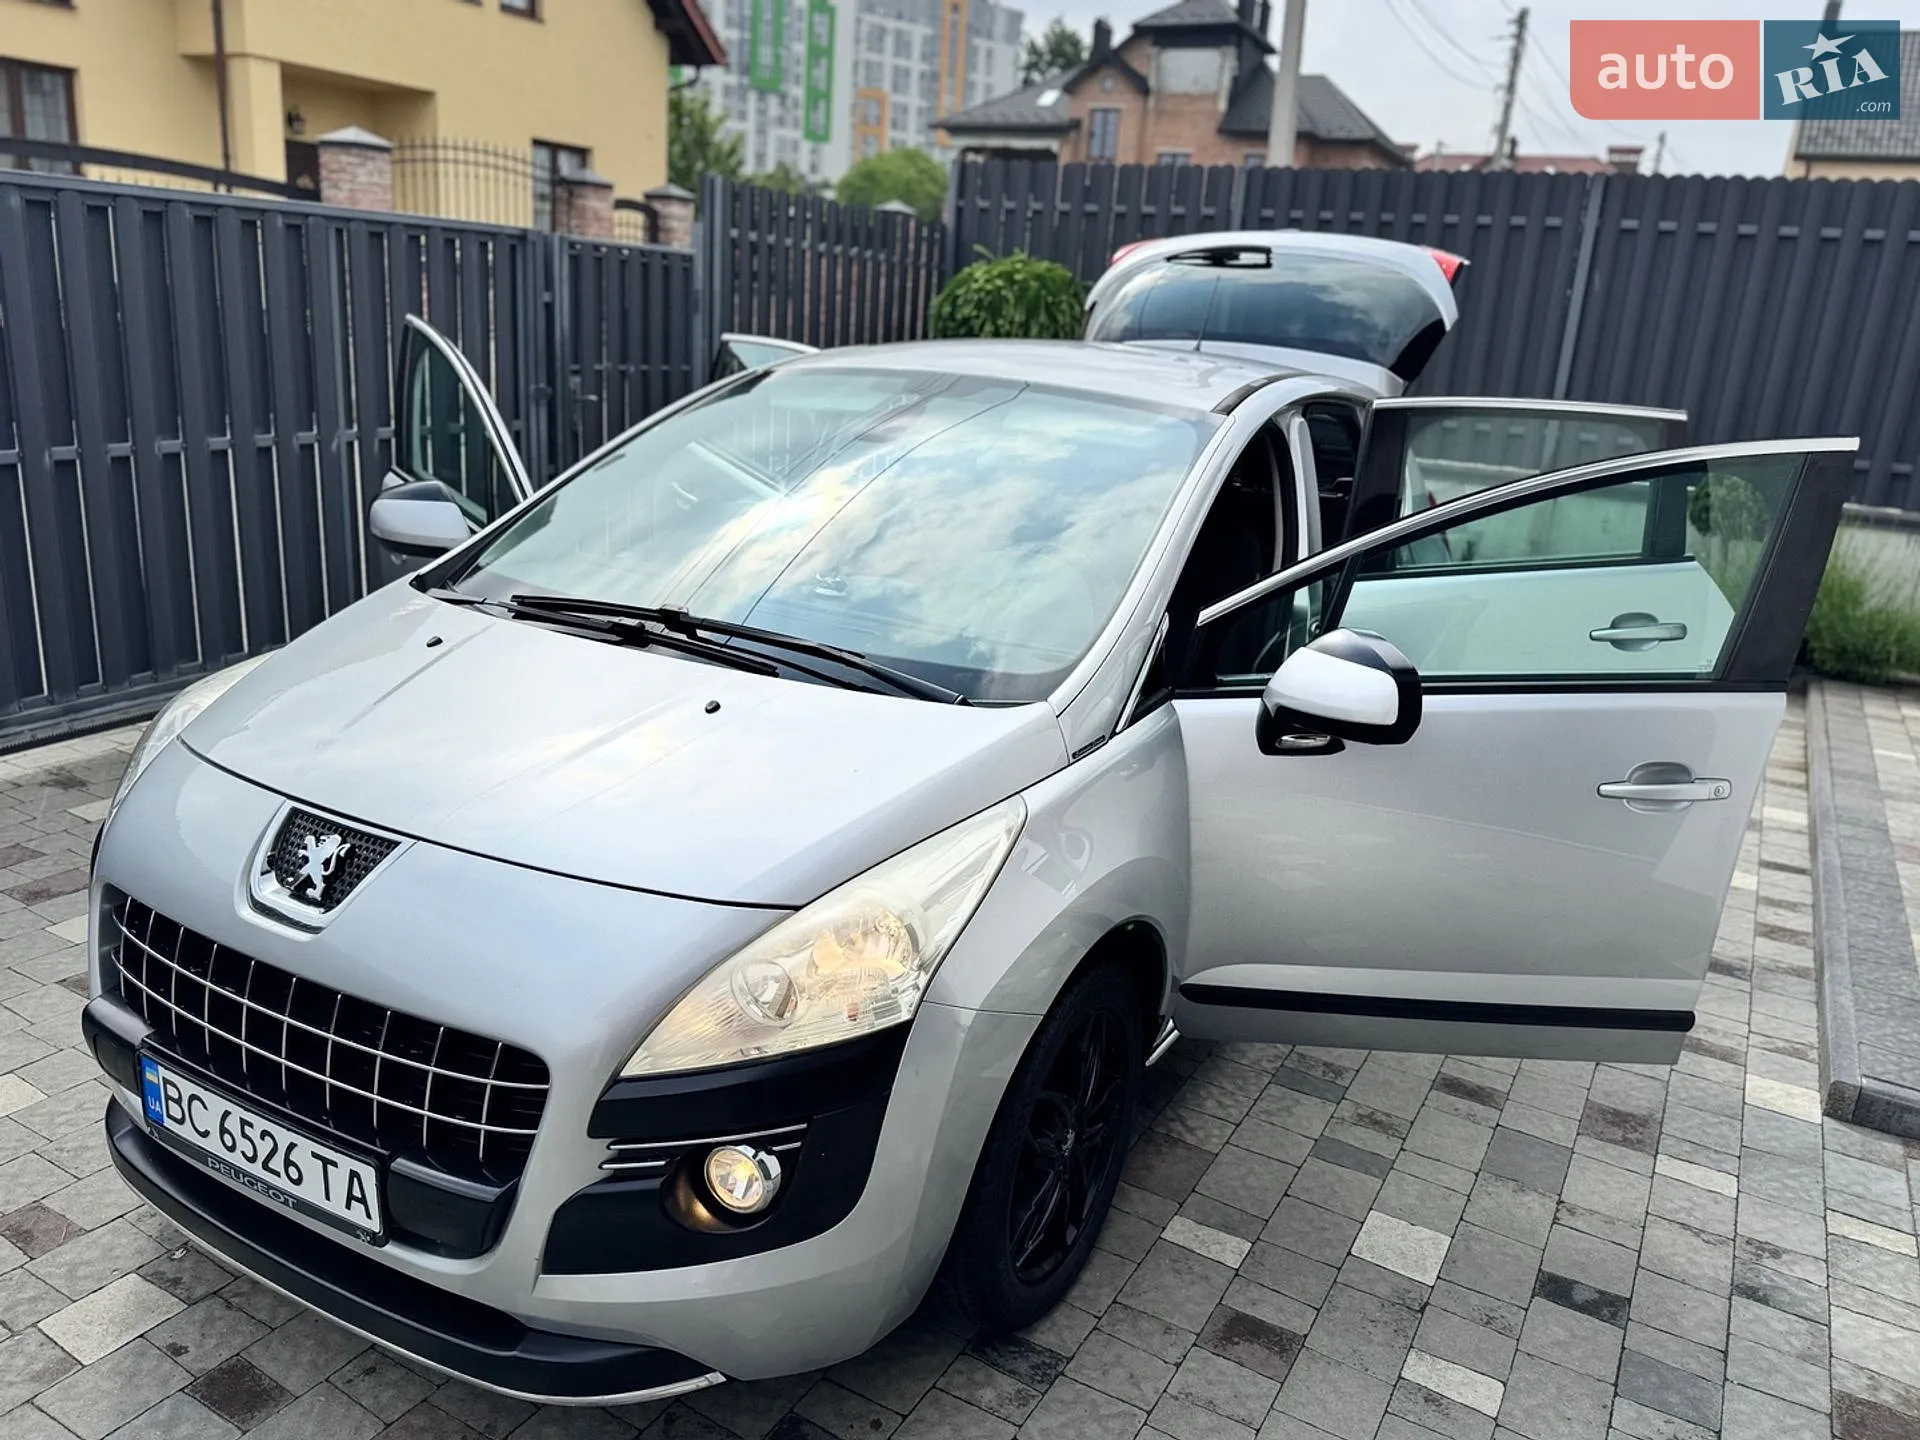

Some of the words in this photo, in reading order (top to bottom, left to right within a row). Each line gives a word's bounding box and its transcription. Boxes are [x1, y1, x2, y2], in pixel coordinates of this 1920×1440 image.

[148, 1096, 162, 1114] UA
[162, 1075, 210, 1138] BC
[218, 1109, 304, 1187] 6526
[310, 1150, 372, 1221] TA
[206, 1156, 298, 1210] PEUGEOT
